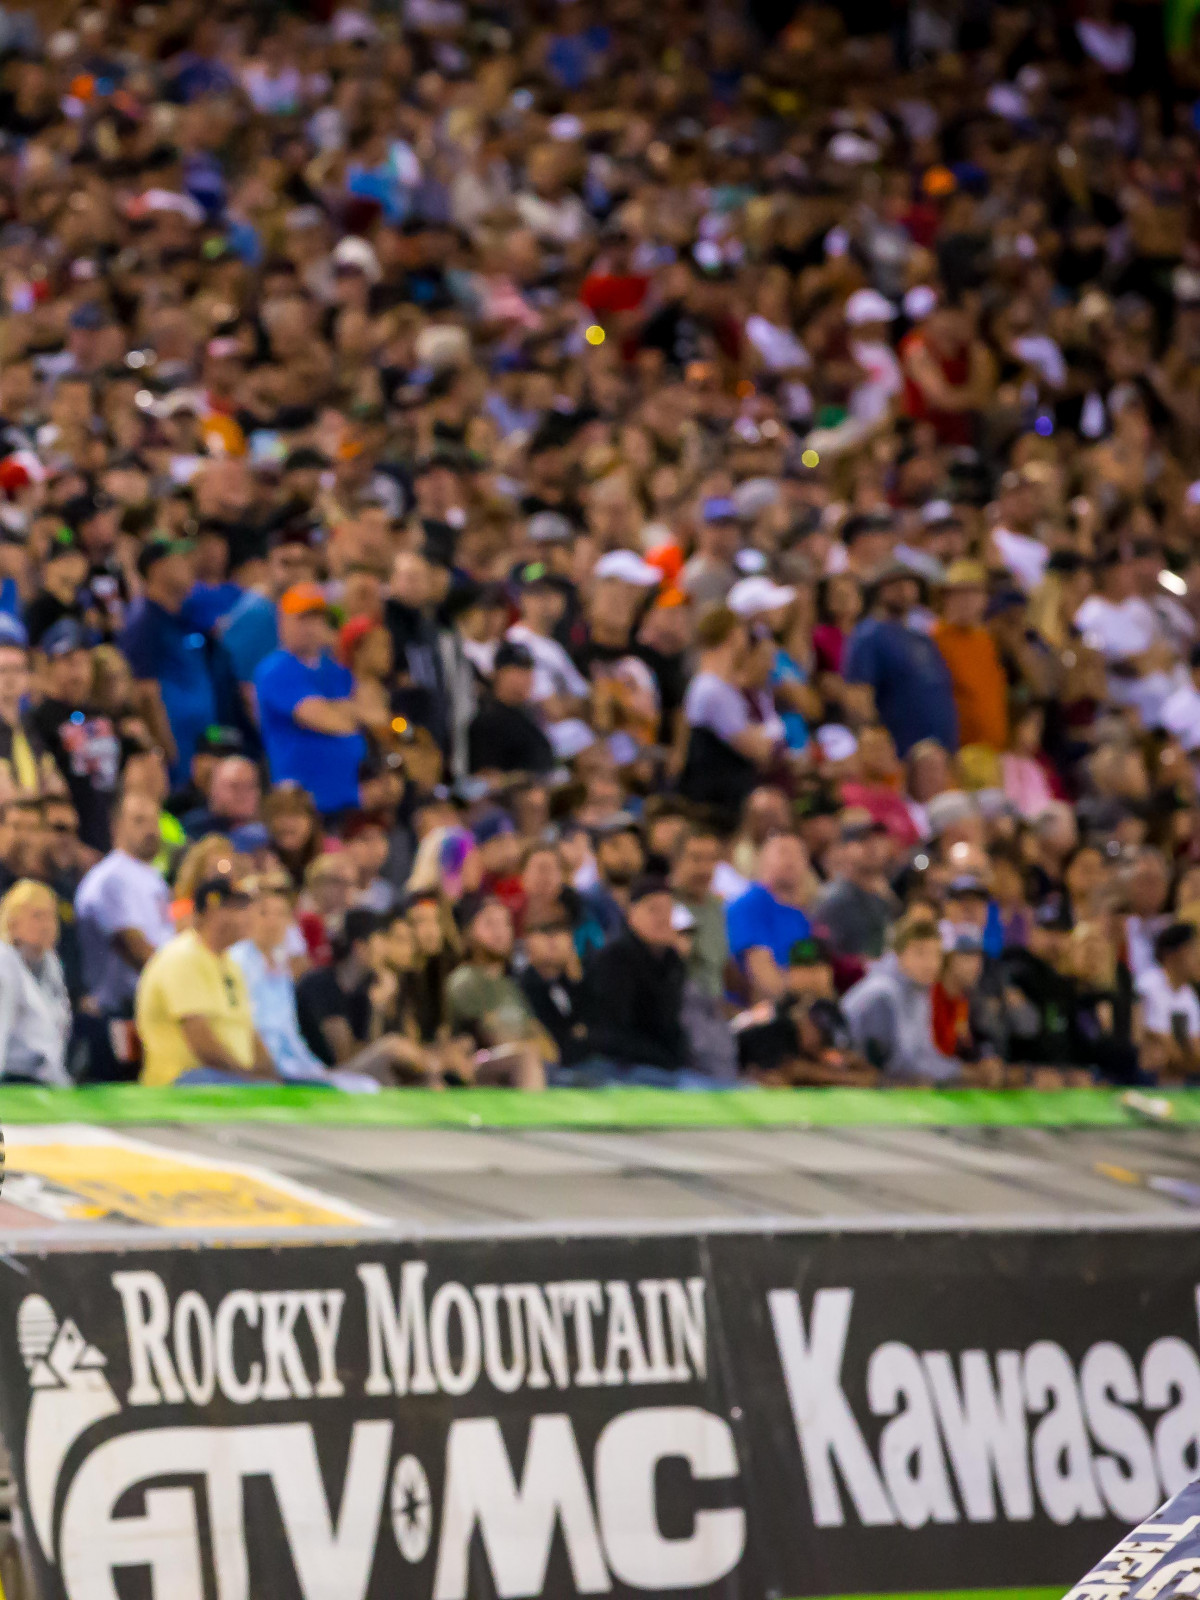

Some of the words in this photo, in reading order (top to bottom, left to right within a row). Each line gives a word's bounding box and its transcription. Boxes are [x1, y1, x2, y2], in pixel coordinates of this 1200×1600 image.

[111, 1270, 345, 1406] ROCKY
[357, 1261, 707, 1396] MOUNTAIN
[767, 1284, 1200, 1530] Kawasa
